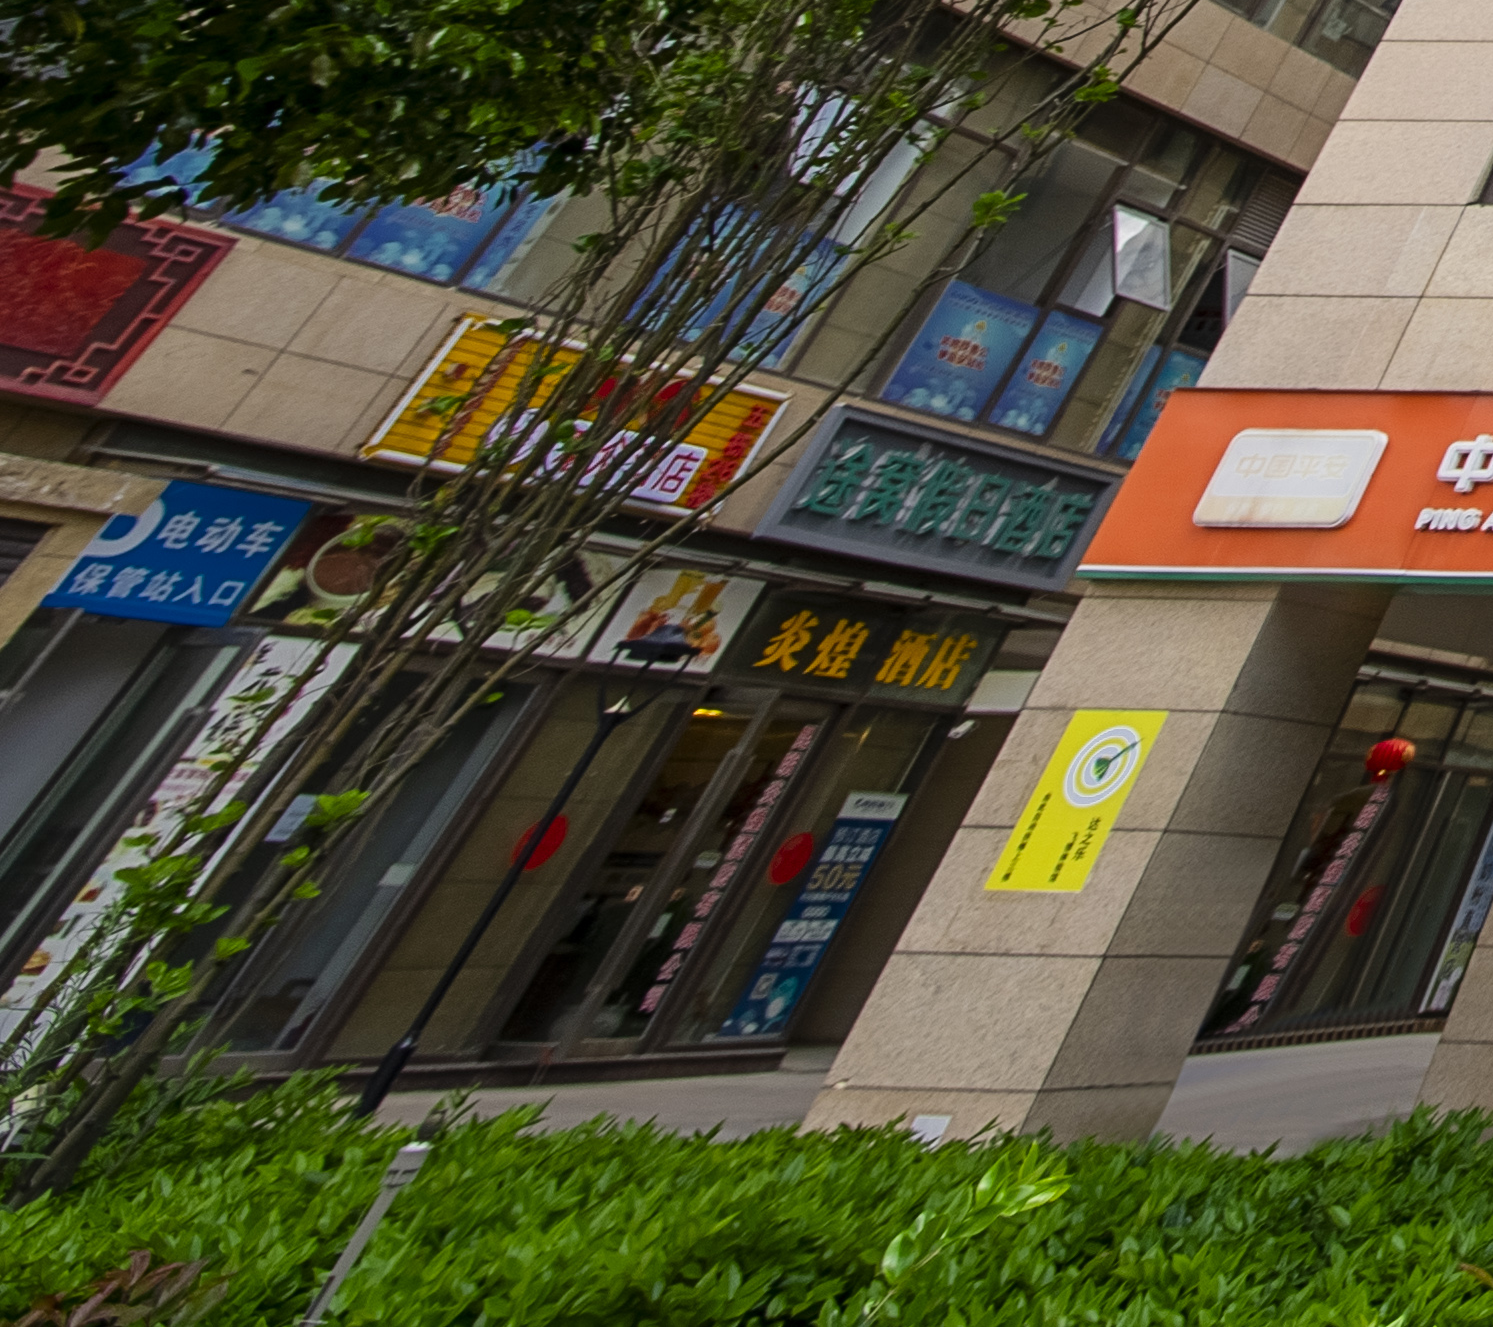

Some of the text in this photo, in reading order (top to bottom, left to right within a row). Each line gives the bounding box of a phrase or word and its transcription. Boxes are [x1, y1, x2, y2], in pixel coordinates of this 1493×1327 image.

[156, 510, 285, 558] 电动车
[1414, 507, 1483, 532] PING
[68, 563, 246, 607] 保管站入口
[806, 864, 863, 891] 50元
